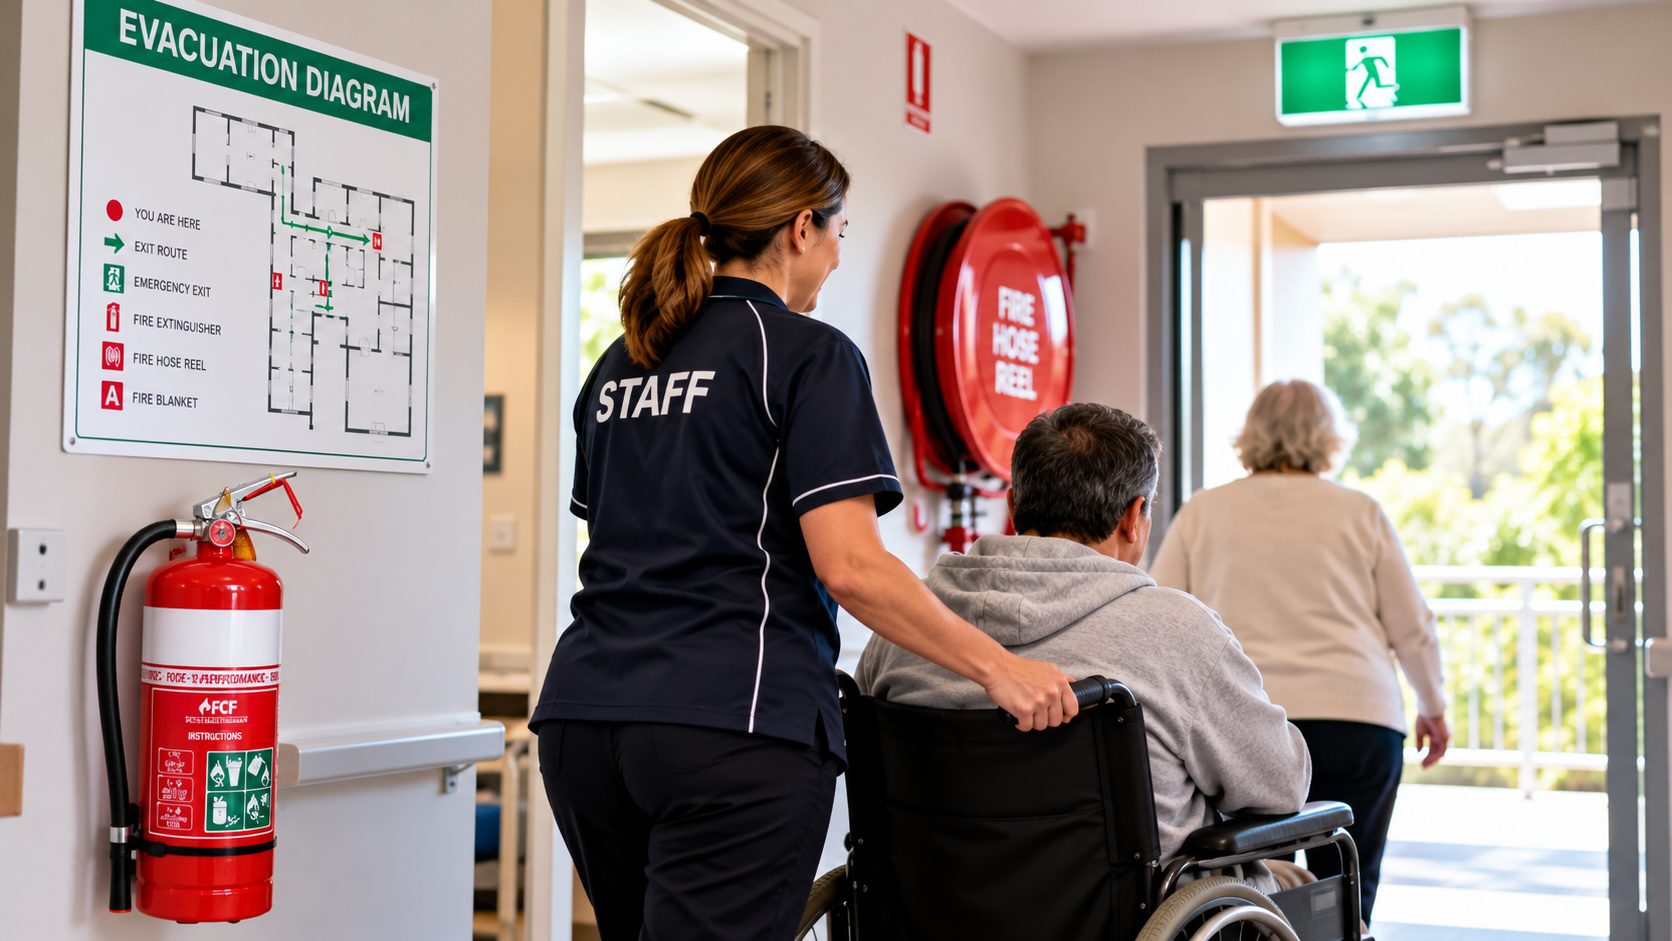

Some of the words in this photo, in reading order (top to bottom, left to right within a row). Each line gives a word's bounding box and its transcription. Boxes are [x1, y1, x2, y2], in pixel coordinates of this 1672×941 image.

[119, 8, 298, 92] EVACUATION
[306, 65, 411, 123] DIAGRAM
[135, 208, 155, 222] YOU
[157, 212, 175, 226] ARE
[178, 216, 201, 231] HERE
[134, 241, 155, 255] EXIT
[157, 245, 188, 260] ROUTE
[134, 276, 191, 294] EMERGENCY
[192, 285, 212, 298] EXIT
[998, 285, 1036, 327] FIRE
[133, 314, 154, 327] FIRE
[156, 316, 222, 336] EXTINGUISHER
[992, 322, 1040, 365] HOSE
[133, 353, 154, 366] FIRE
[156, 355, 182, 369] HOSE
[184, 358, 207, 371] REEL
[995, 360, 1038, 401] REEL
[104, 384, 120, 406] A
[132, 392, 154, 405] FIRE
[156, 394, 199, 408] BLANKET
[596, 370, 717, 423] STAFF
[211, 699, 238, 715] FCF
